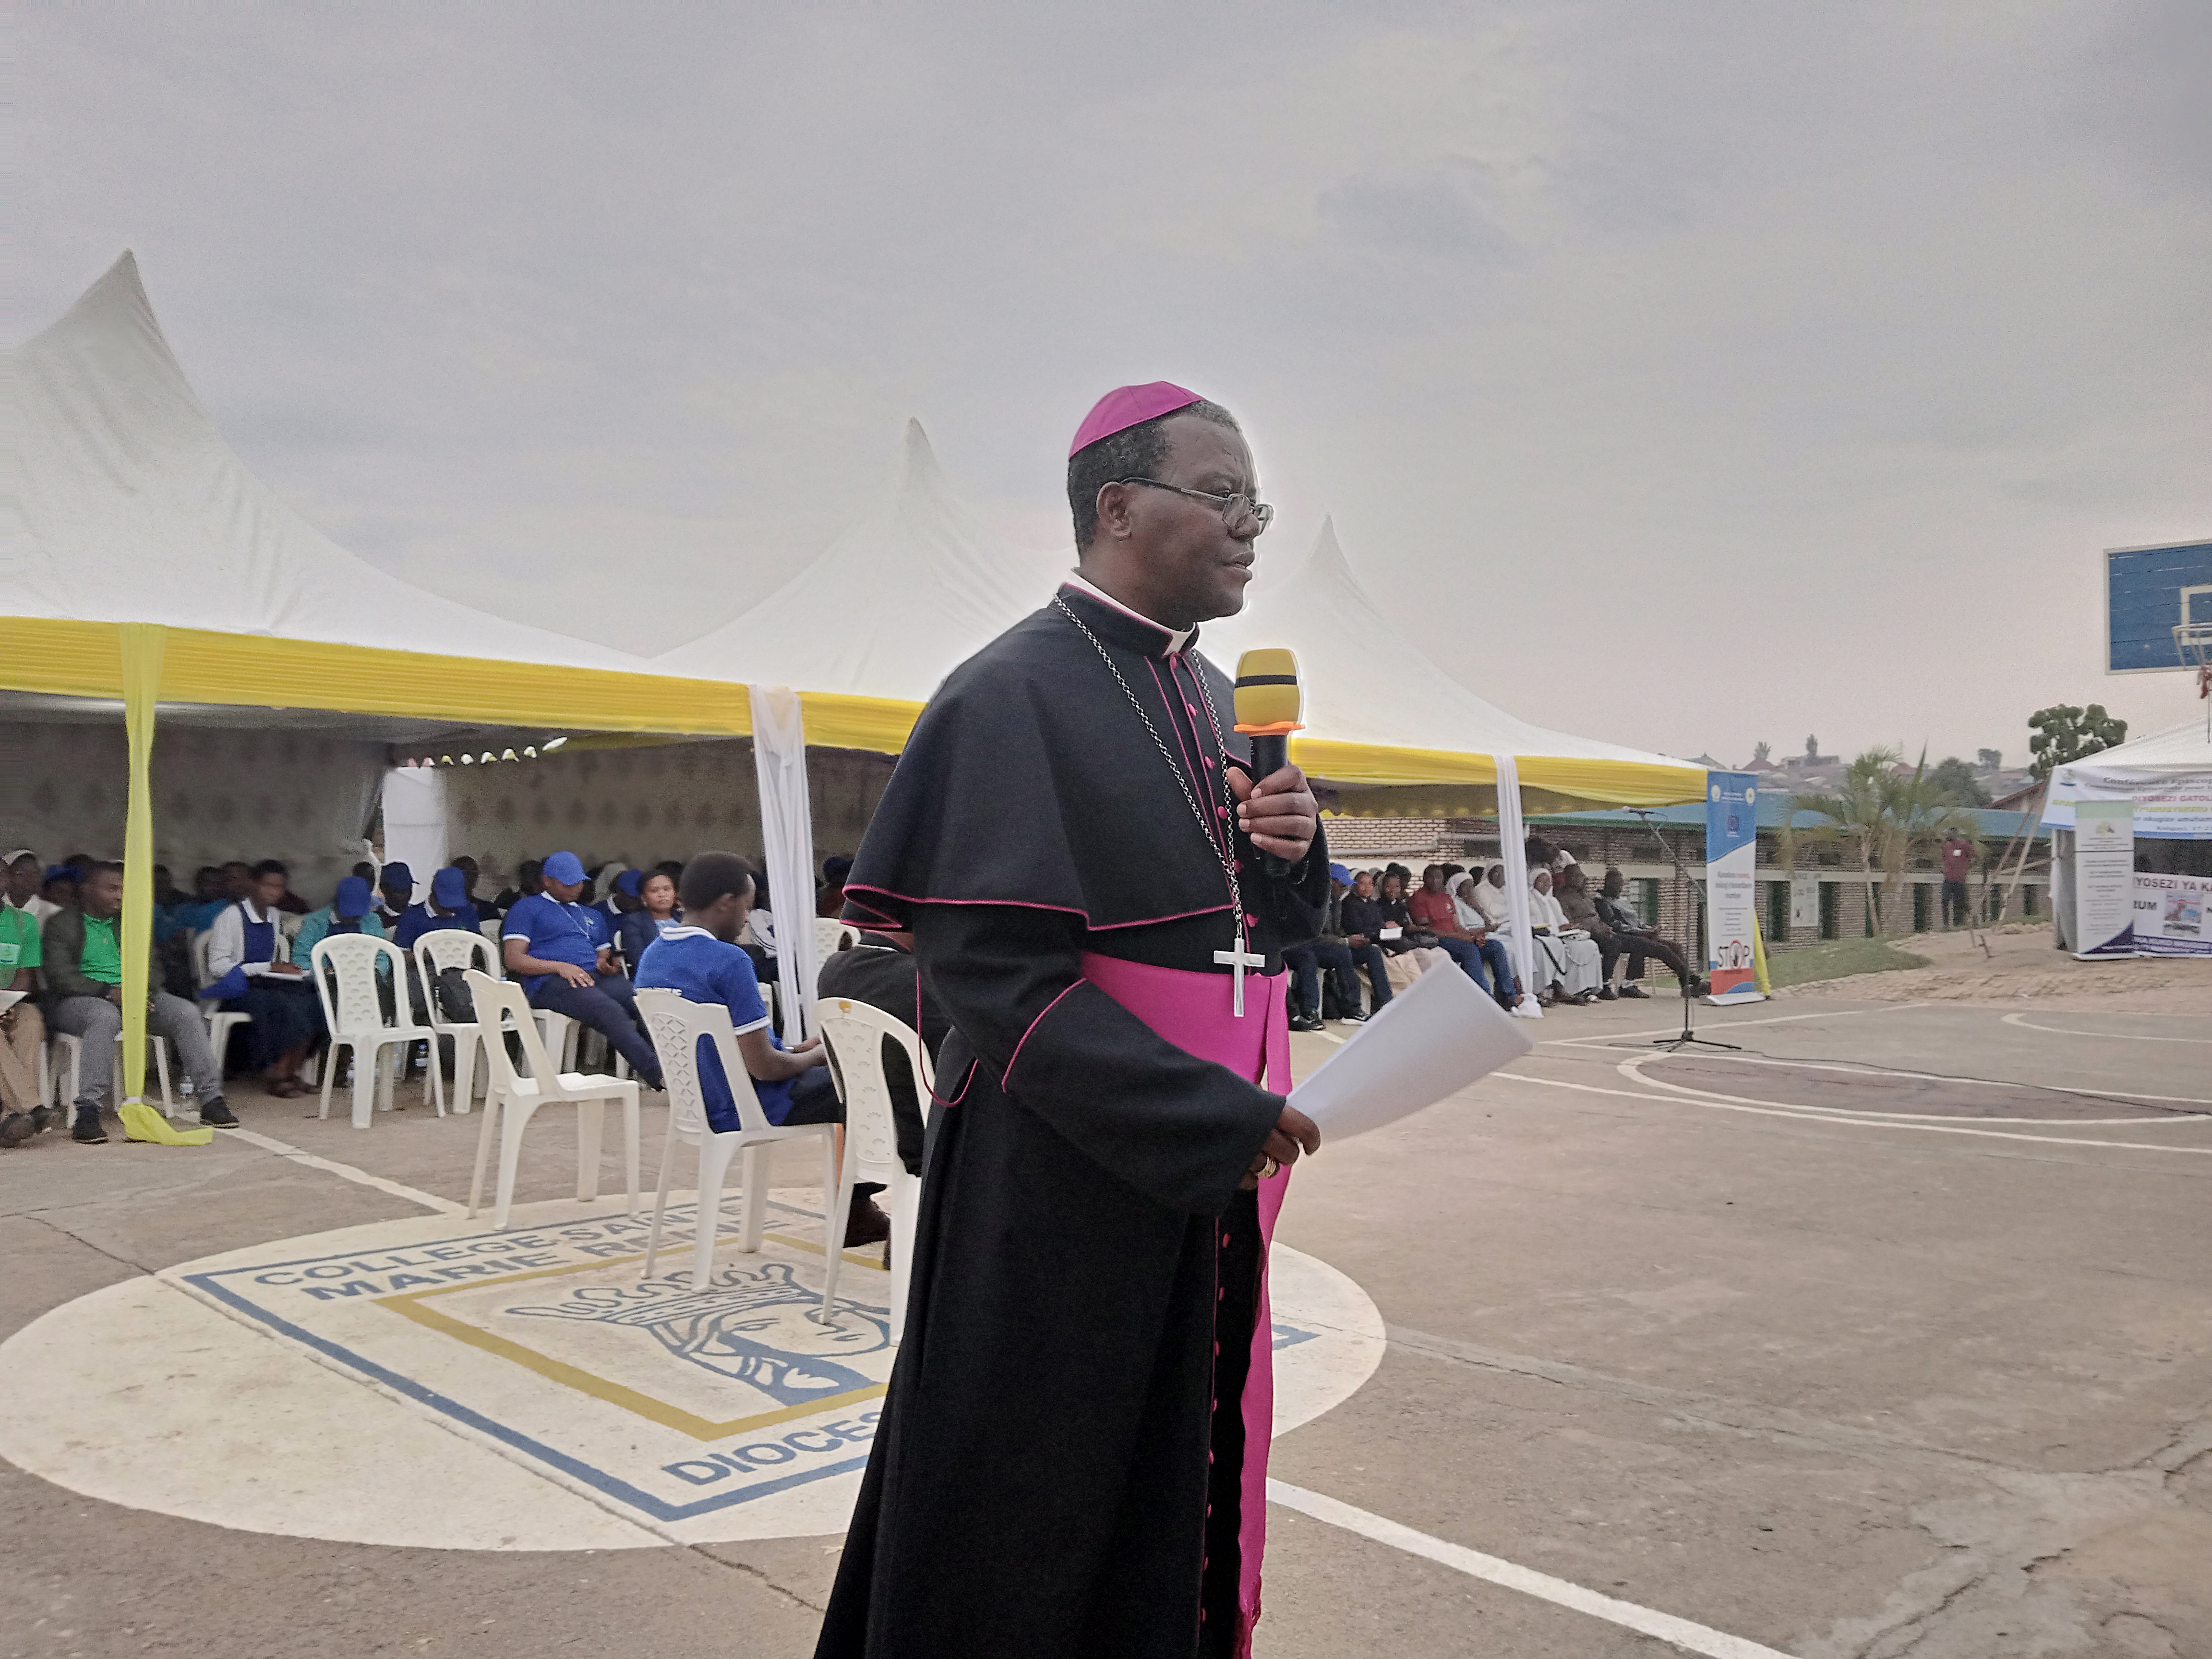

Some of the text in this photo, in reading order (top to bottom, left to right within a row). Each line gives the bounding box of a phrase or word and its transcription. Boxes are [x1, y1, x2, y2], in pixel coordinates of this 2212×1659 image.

[2182, 880, 2197, 890] YA
[2201, 882, 2212, 891] K
[254, 1235, 558, 1285] COLLEGE
[301, 1252, 572, 1299] MARIE
